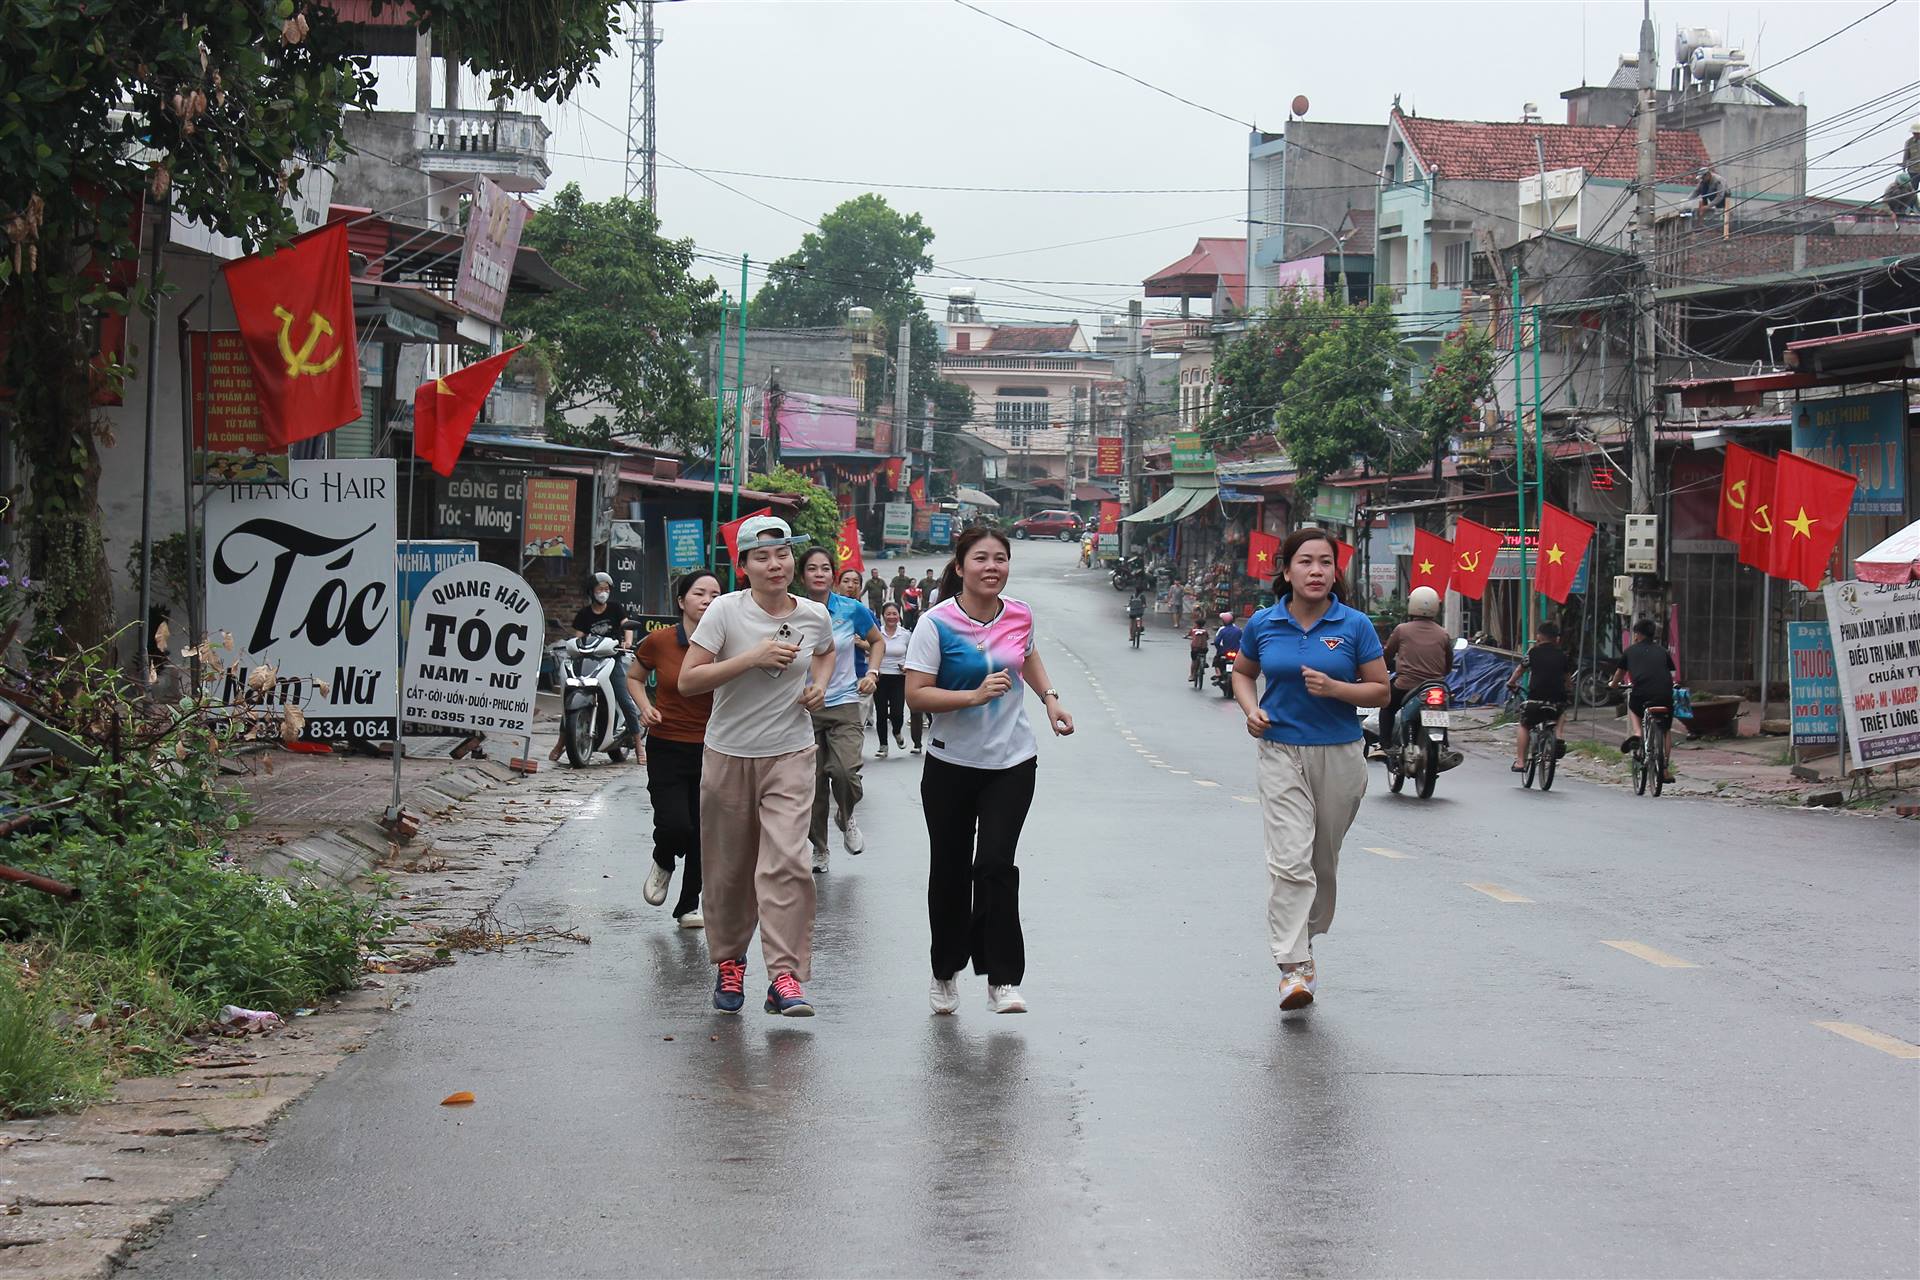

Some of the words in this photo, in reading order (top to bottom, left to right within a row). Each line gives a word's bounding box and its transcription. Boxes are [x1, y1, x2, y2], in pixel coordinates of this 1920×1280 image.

[448, 478, 498, 498] CÔNG
[439, 504, 461, 526] Tóc
[475, 505, 513, 533] Móng
[397, 550, 431, 572] NGHĨA
[213, 518, 389, 655] Tóc
[432, 580, 491, 605] QUANG
[494, 584, 530, 614] HẬU
[620, 579, 633, 592] ÉP
[425, 608, 528, 666] TÓC
[1792, 639, 1833, 679] THUỐC
[330, 666, 381, 705] Nữ
[419, 664, 469, 684] NAM
[489, 671, 522, 690] NỮ
[1868, 664, 1905, 684] CHUẨN
[311, 721, 347, 738] 834
[353, 720, 390, 737] 064
[406, 706, 428, 718] ĐT:
[431, 709, 465, 722] 0395
[470, 715, 495, 727] 130
[499, 718, 524, 730] 782
[1860, 711, 1888, 734] TRIỆT
[1890, 708, 1919, 728] LÔNG
